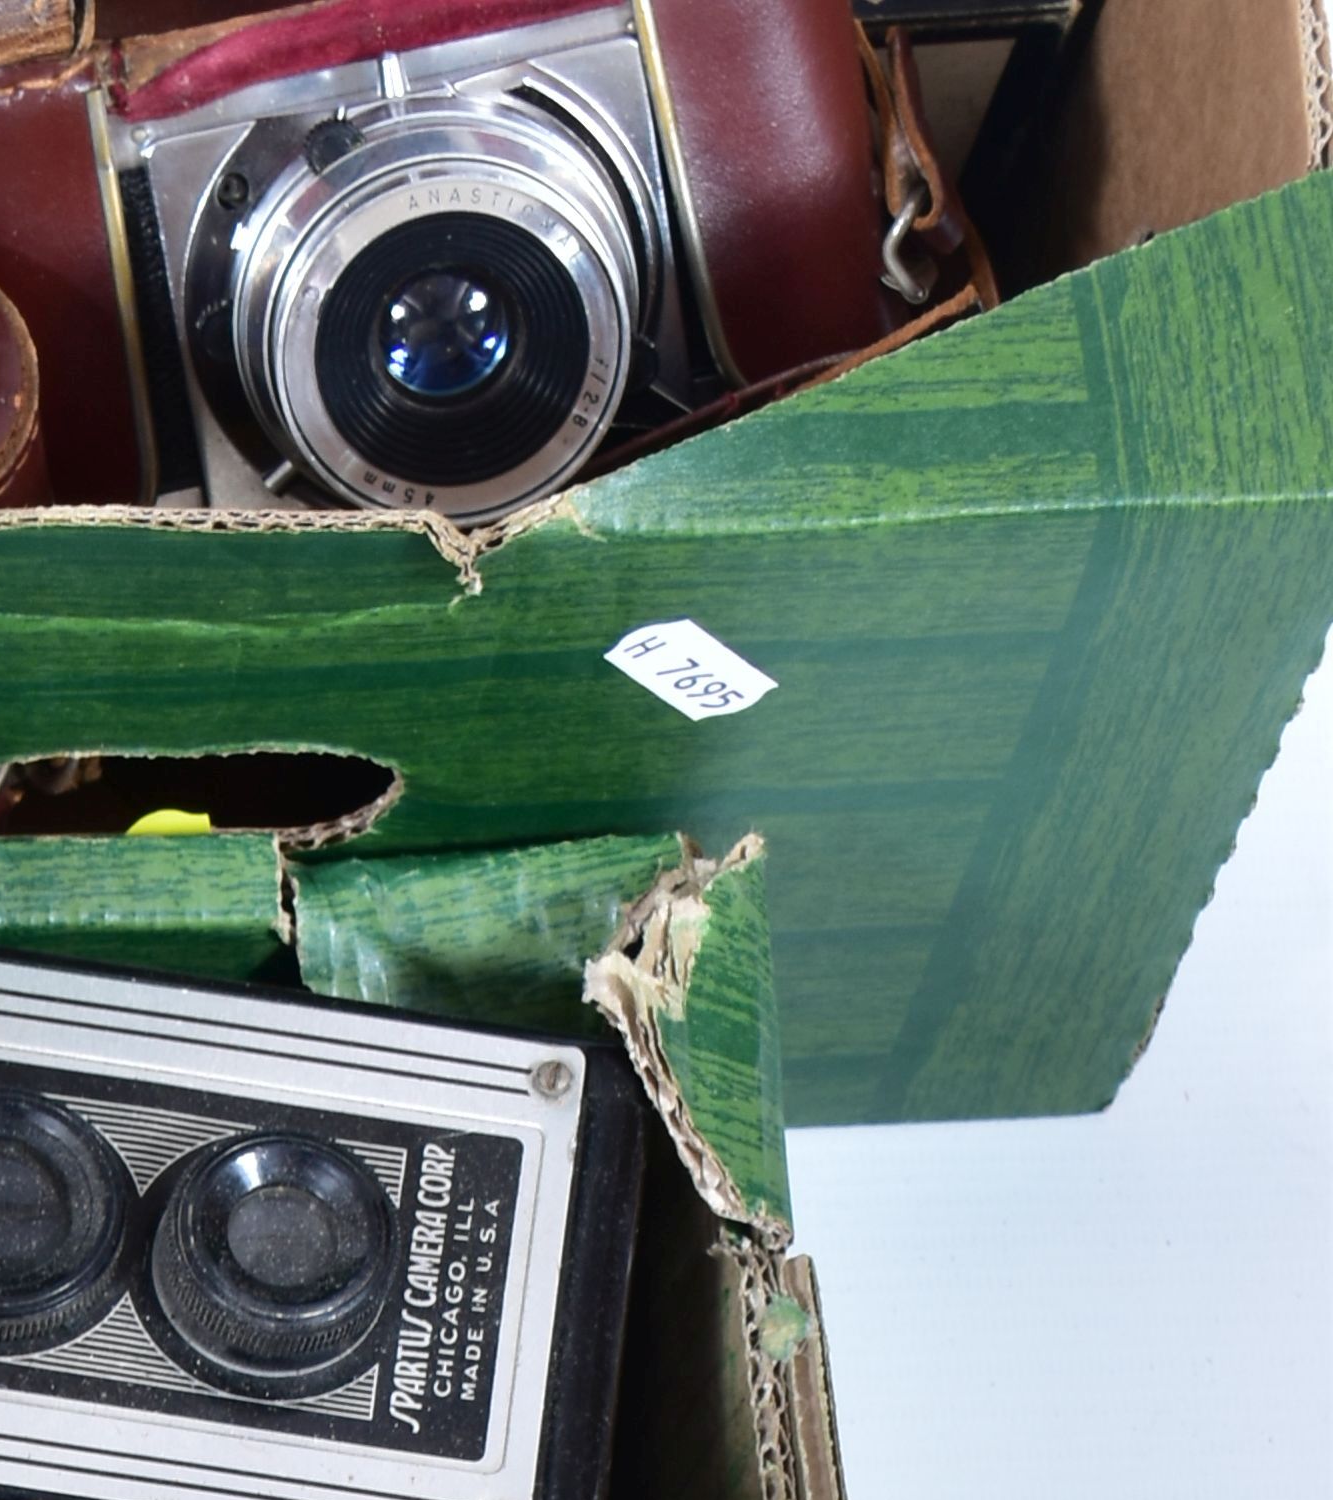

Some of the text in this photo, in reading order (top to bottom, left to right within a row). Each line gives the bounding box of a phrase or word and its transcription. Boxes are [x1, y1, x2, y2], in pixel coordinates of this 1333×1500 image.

[623, 635, 746, 709] H 7695
[452, 1196, 476, 1241] ILL
[389, 1142, 456, 1435] SPARTUS CAMERA CORP.
[470, 1287, 488, 1313] IN
[459, 1327, 485, 1401] MADE
